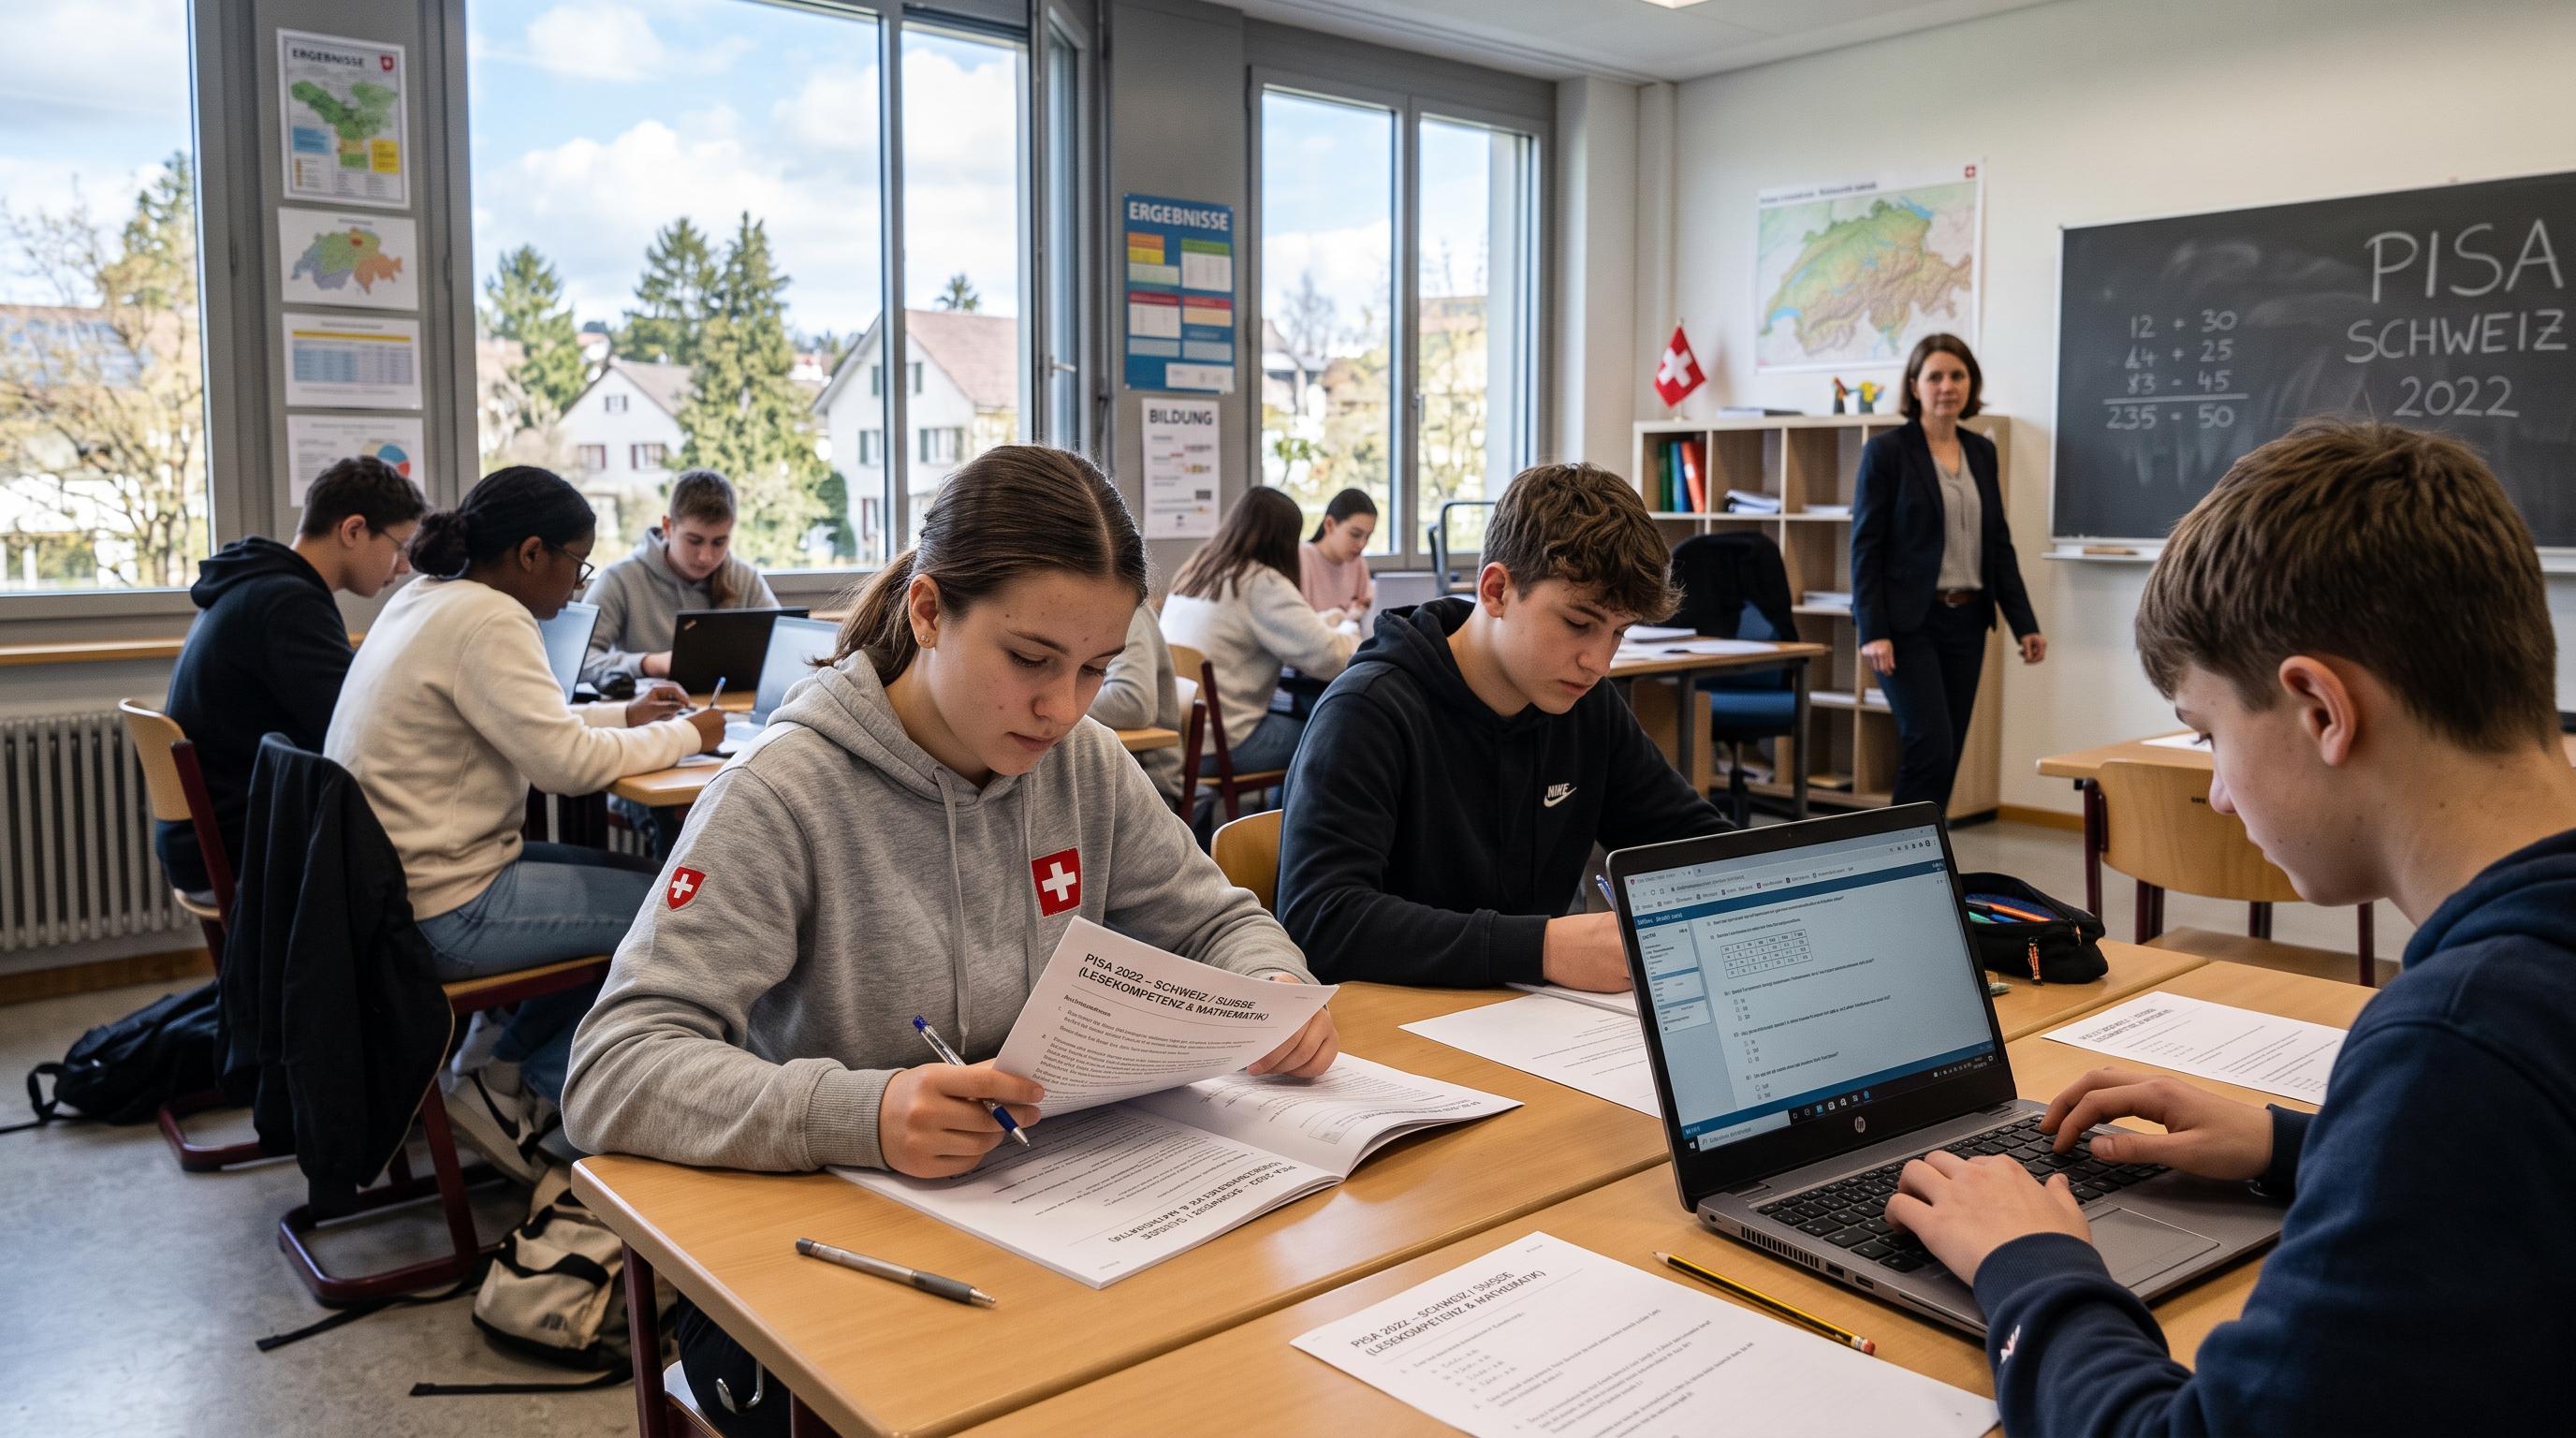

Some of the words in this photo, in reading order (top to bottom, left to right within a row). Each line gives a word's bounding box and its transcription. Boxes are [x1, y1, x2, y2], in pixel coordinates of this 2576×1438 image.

[1129, 201, 1229, 231] ERGEBNISSE
[2364, 218, 2564, 303] PISA
[2130, 315, 2156, 339] 12
[2201, 309, 2238, 332] 30
[2345, 309, 2568, 363] SCHWEIZ
[2201, 338, 2233, 362] 25
[2198, 369, 2232, 392] 45
[2393, 374, 2520, 418] 2022
[1149, 408, 1213, 425] BILDUNG
[2106, 404, 2158, 430] 235
[2199, 404, 2234, 429] 50
[1547, 783, 1570, 798] NIKE
[1084, 953, 1112, 972] PISA
[1114, 966, 1144, 983] 2022
[1153, 980, 1209, 1002] SCHWEIZ
[1078, 967, 1188, 1009] (LESEKOMPETENZ
[1185, 1004, 1193, 1012] &
[1195, 1005, 1269, 1020] MATHEMATIK)
